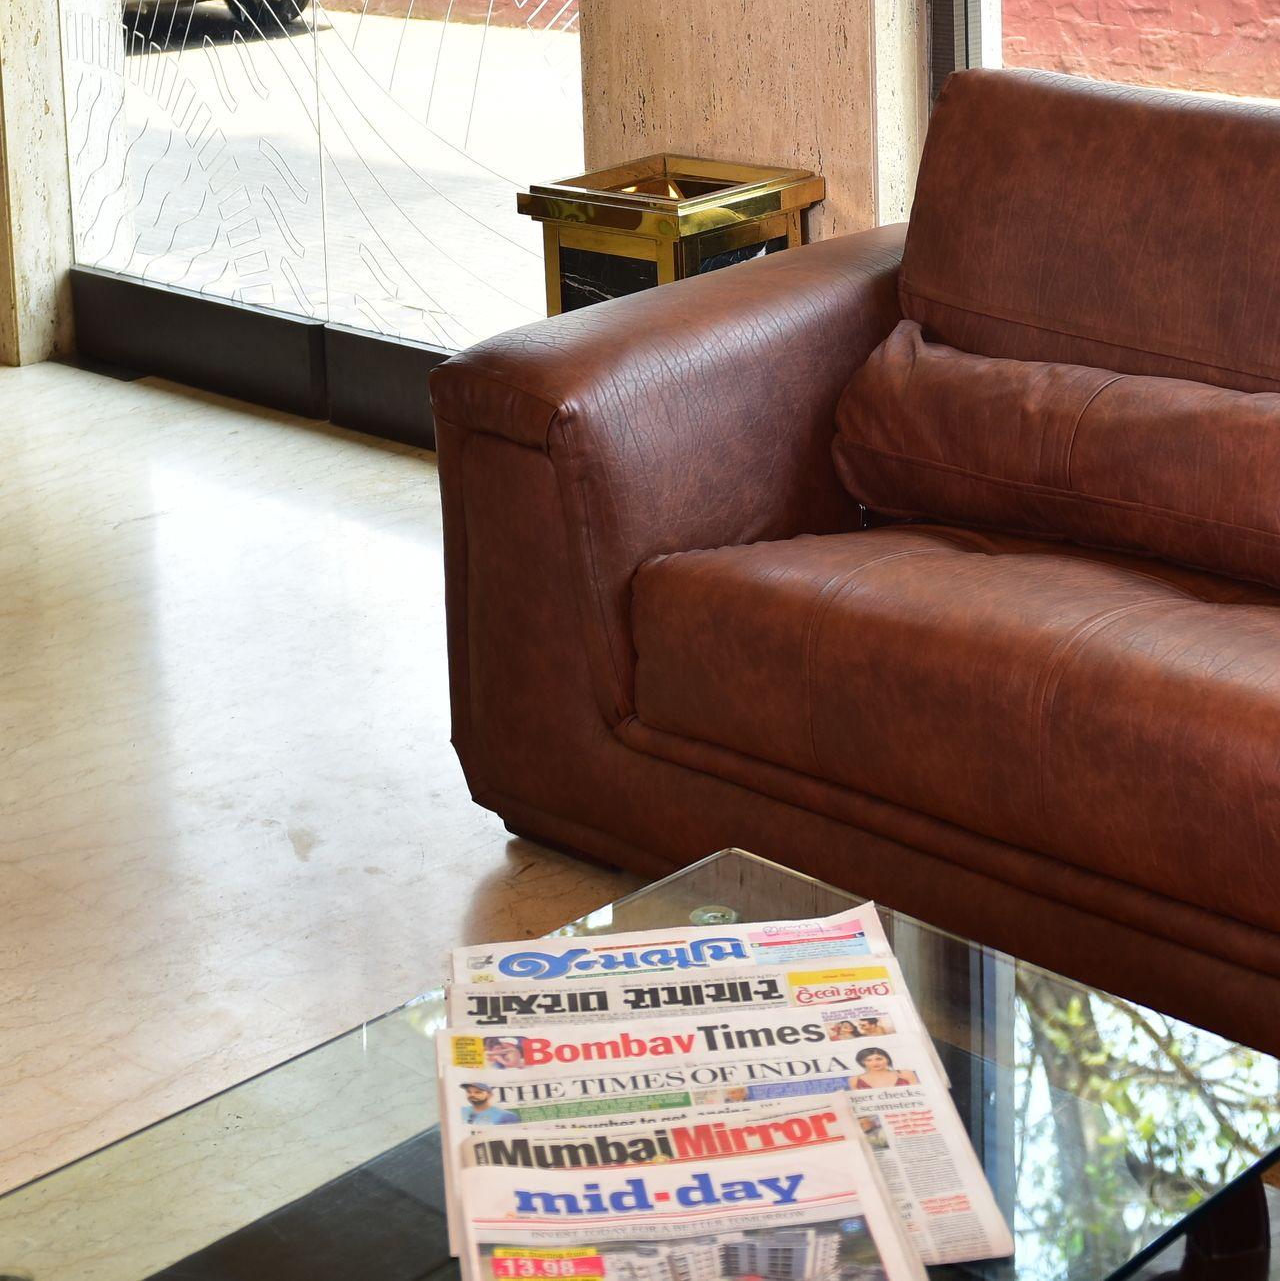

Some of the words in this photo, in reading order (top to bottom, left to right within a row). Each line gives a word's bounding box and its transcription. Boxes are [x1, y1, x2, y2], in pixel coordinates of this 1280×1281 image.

[467, 990, 609, 1026] ગુજરાત
[623, 979, 785, 1010] સમાચાર
[523, 1032, 696, 1066] Bombay
[697, 1023, 826, 1052] Times
[492, 1082, 565, 1104] THE
[573, 1070, 686, 1096] TIMES
[690, 1063, 743, 1085] OF
[748, 1056, 851, 1080] INDIA
[488, 1130, 674, 1169] Mumbai
[671, 1111, 838, 1159] Mirror
[632, 1224, 657, 1233] FOR
[673, 1220, 723, 1232] BETTER
[729, 1210, 806, 1226] TOMORROW
